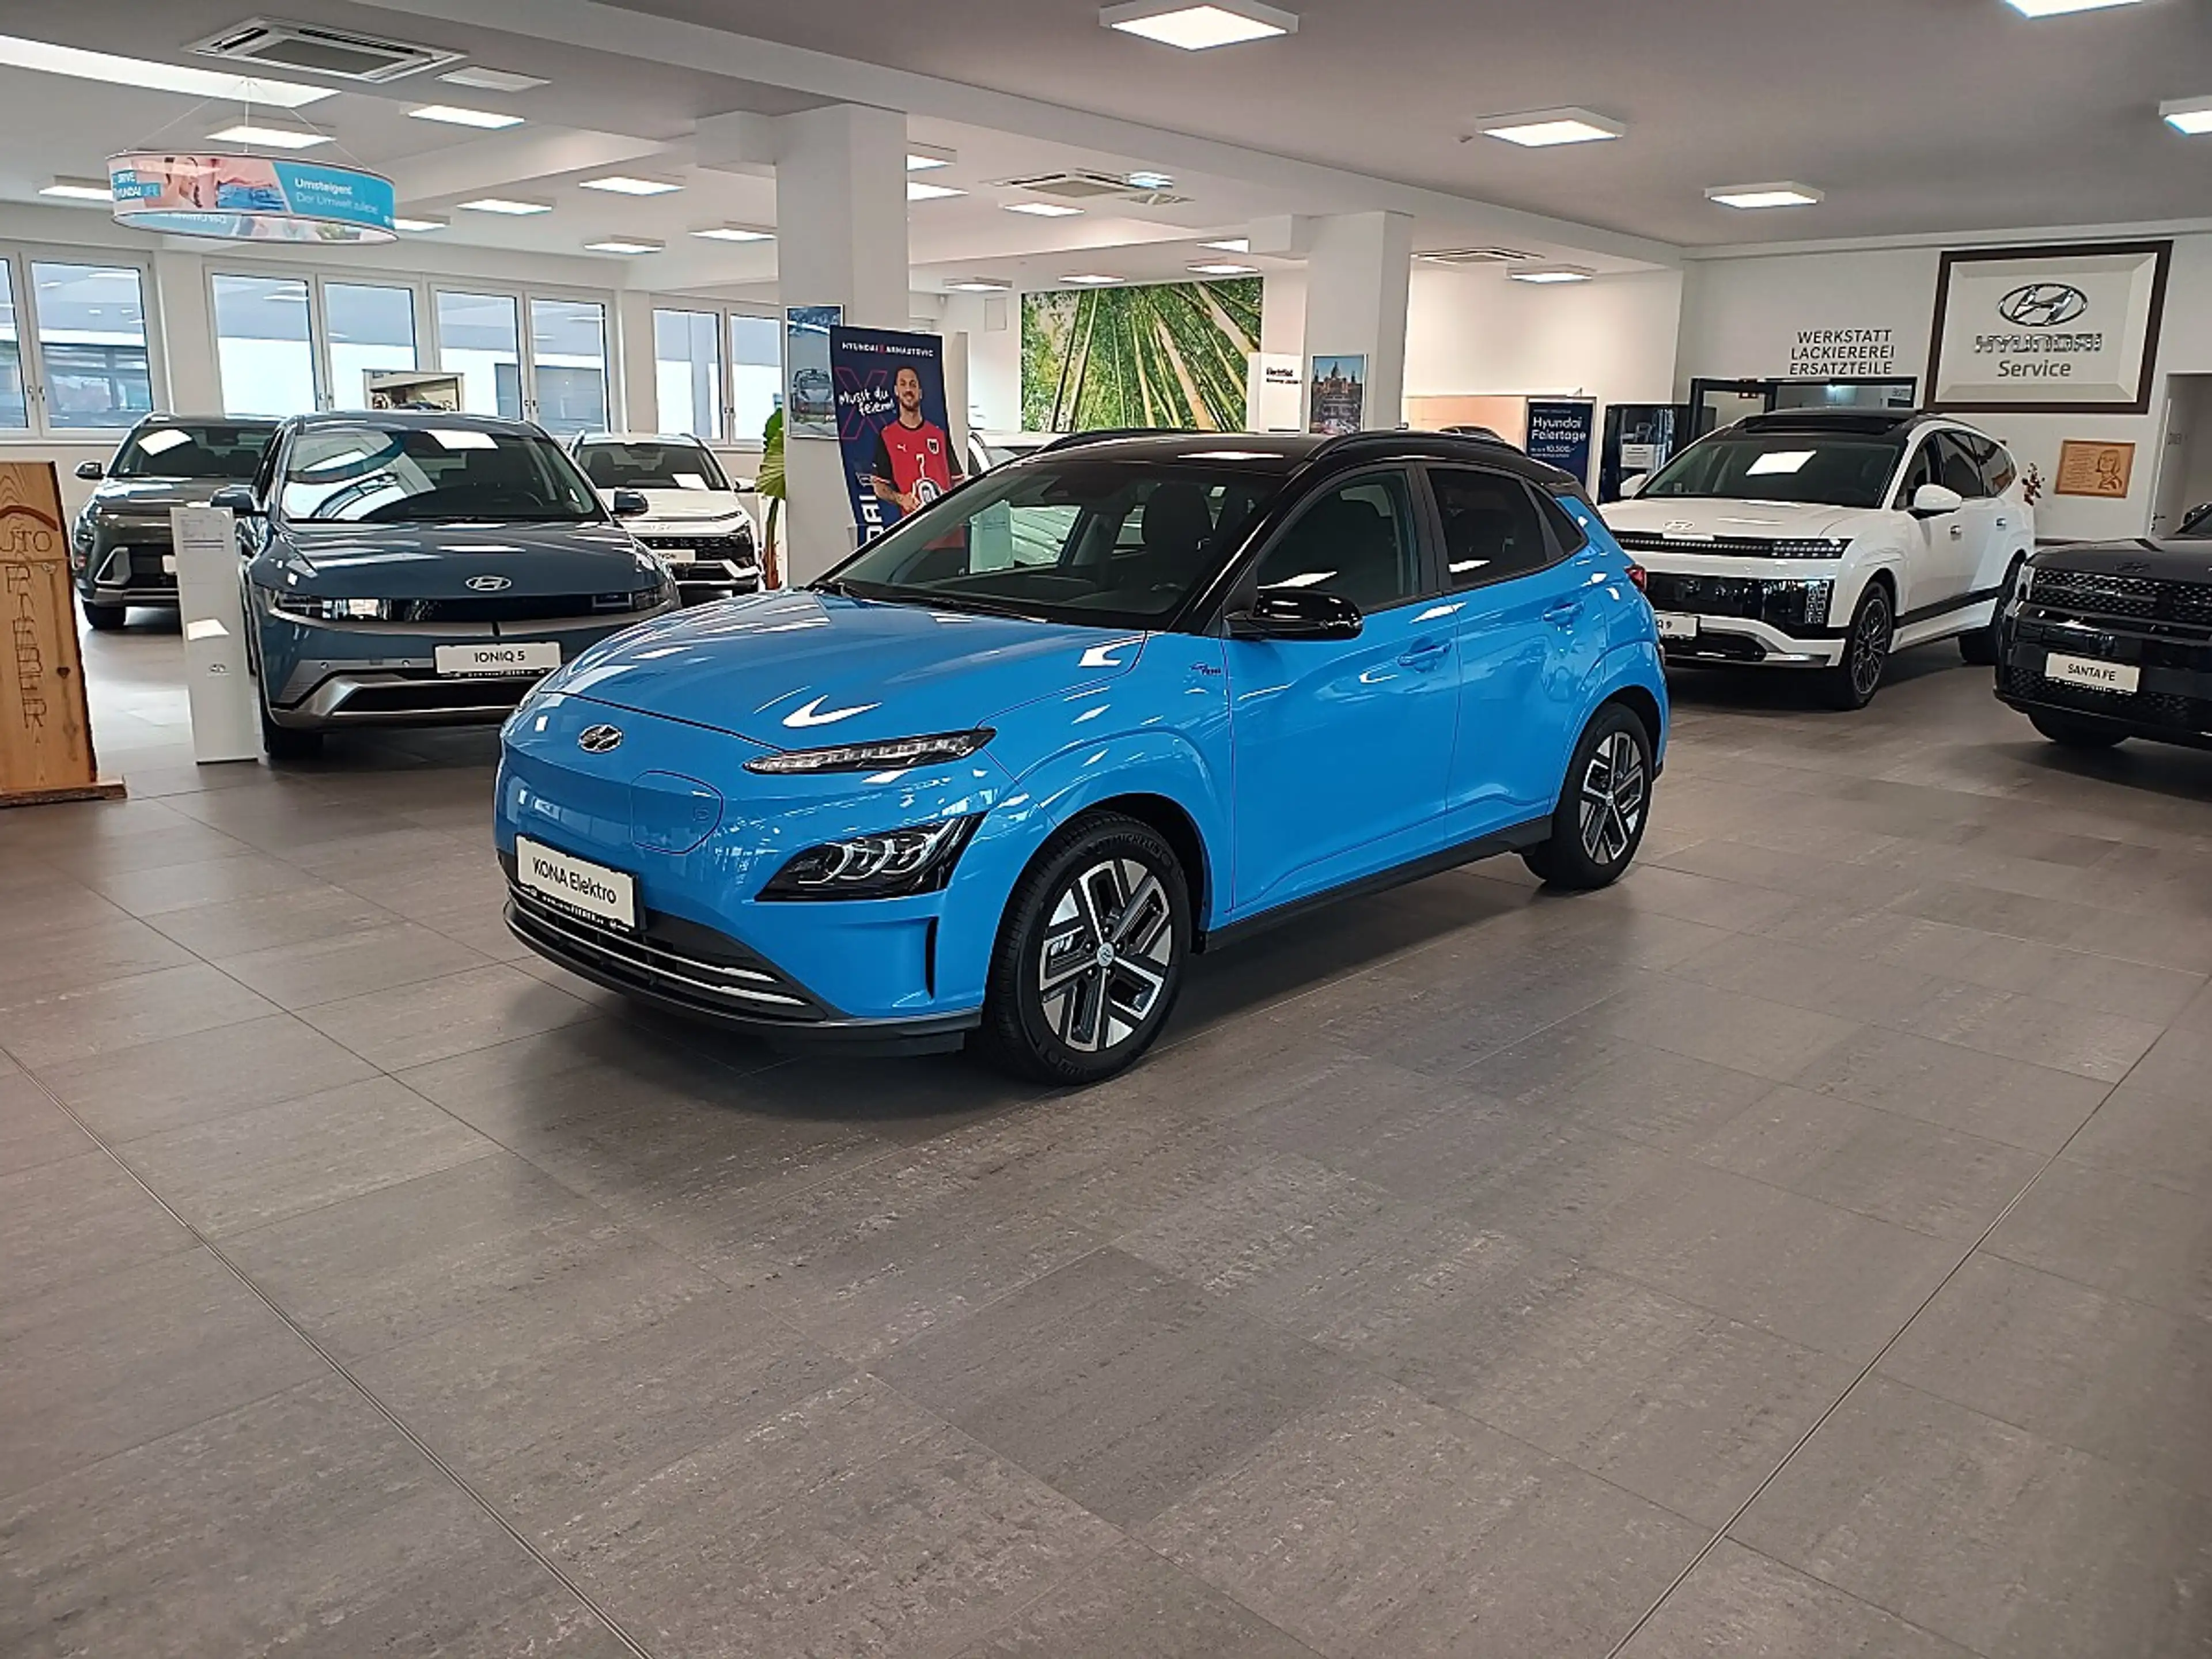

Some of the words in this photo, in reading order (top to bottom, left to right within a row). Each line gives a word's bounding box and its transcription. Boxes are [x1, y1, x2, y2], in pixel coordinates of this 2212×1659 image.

[1797, 329, 1893, 344] WERKSTATT
[1974, 332, 2103, 353] HYUNDAI
[1791, 344, 1895, 361] LACKIEREREI
[1789, 361, 1893, 376] ERSATZTEILE
[1997, 359, 2071, 377] Service
[874, 386, 889, 402] du
[1533, 416, 1583, 430] Hyundai
[1531, 429, 1586, 443] Feiertage
[0, 530, 52, 552] UTO
[474, 650, 516, 663] IONIQ
[517, 650, 526, 661] 5
[2067, 663, 2101, 679] SANTA
[2101, 669, 2117, 681] FE
[569, 871, 618, 904] Elektro
